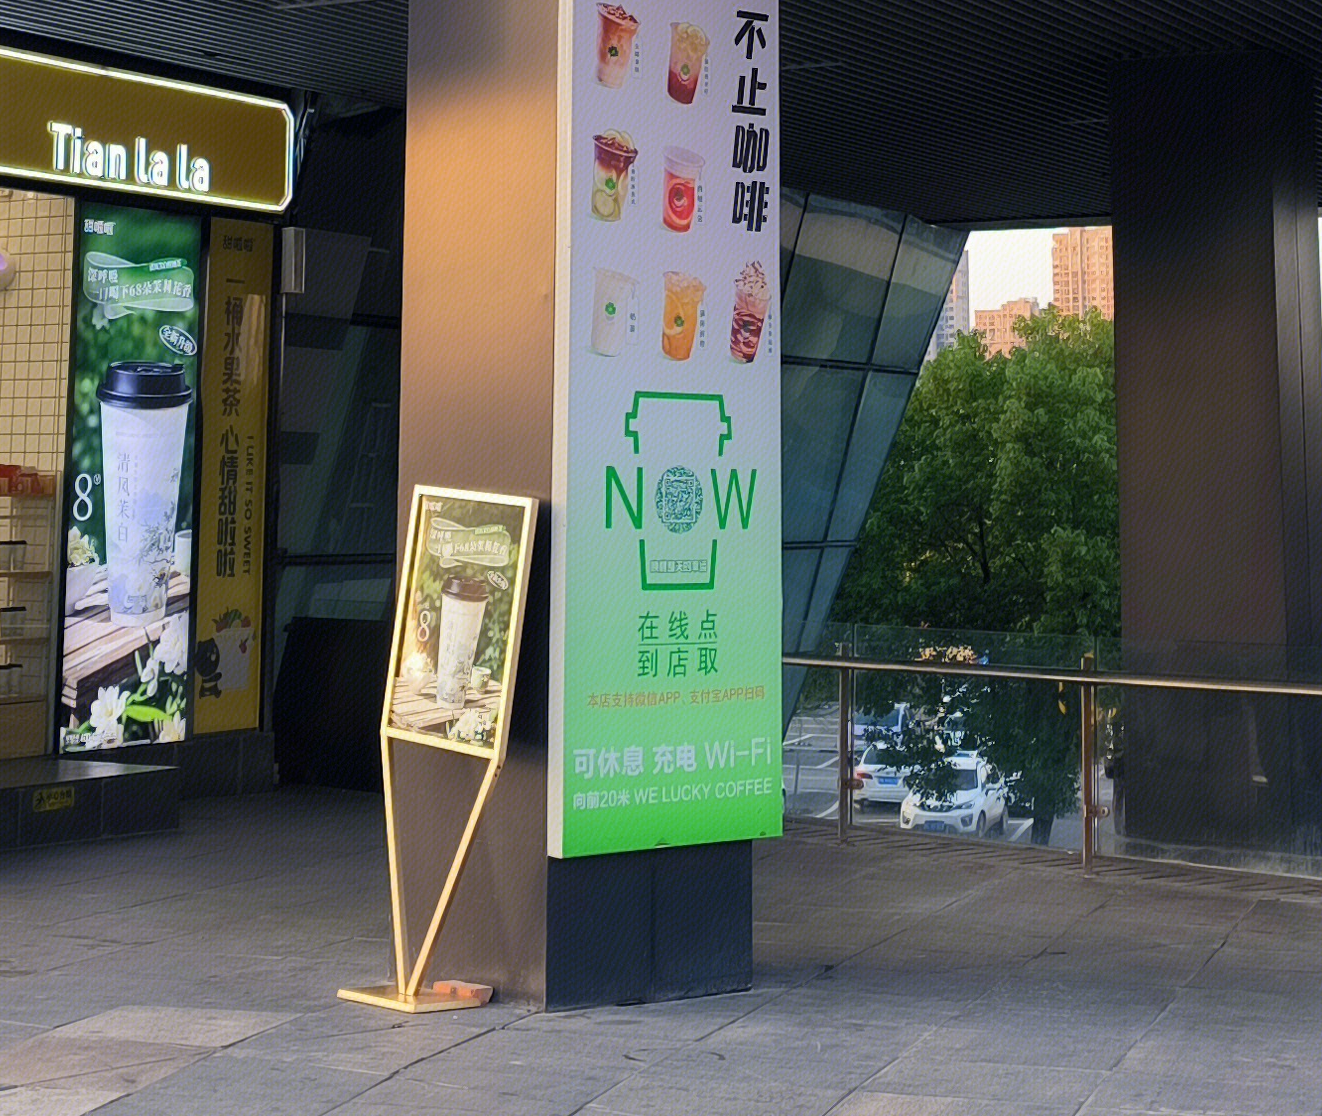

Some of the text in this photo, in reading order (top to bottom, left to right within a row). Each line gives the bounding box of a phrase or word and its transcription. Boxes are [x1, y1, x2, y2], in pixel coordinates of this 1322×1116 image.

[731, 10, 770, 232] 不止咖啡
[48, 121, 126, 180] Tian
[637, 609, 718, 642] 在线点
[637, 647, 718, 678] 到店取
[573, 736, 772, 780] 可休息 充电 Wi-Fi
[573, 777, 773, 810] 向前20米 WE LUCKY COFFEE
